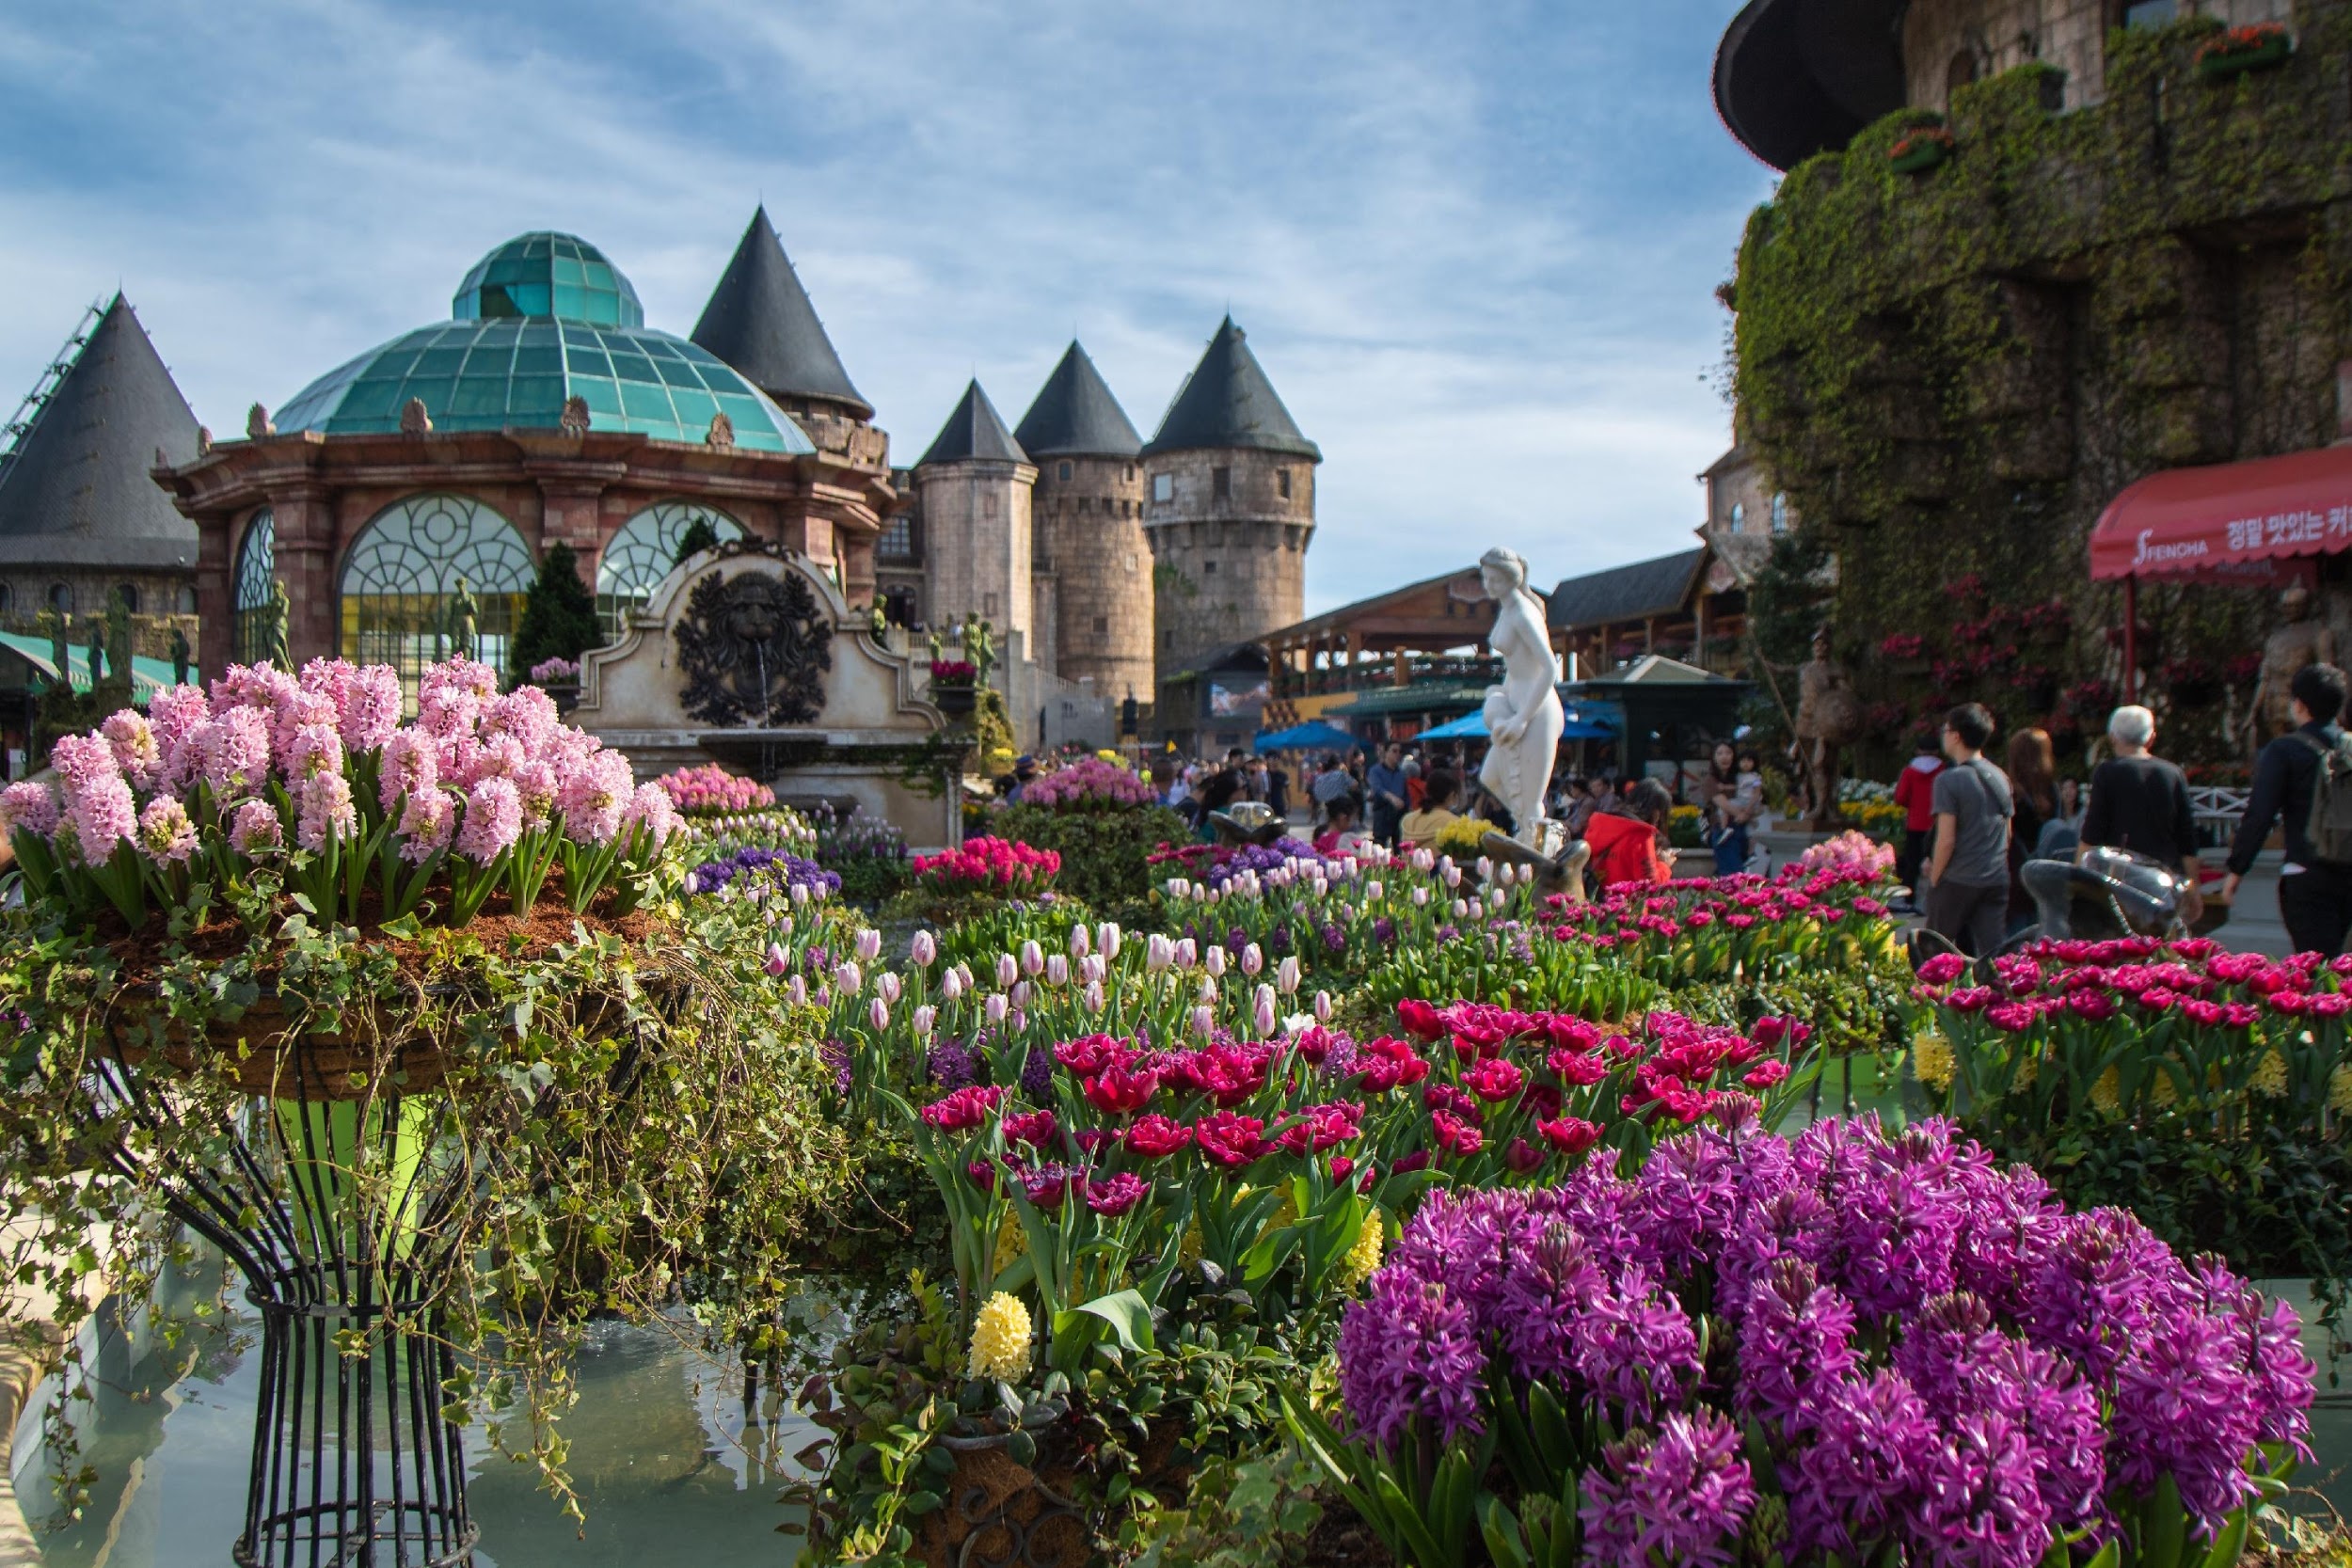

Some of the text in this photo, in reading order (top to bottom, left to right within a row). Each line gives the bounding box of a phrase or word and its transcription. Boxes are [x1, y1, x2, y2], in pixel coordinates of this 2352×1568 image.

[2227, 504, 2352, 551] 정말 맛있는 커
